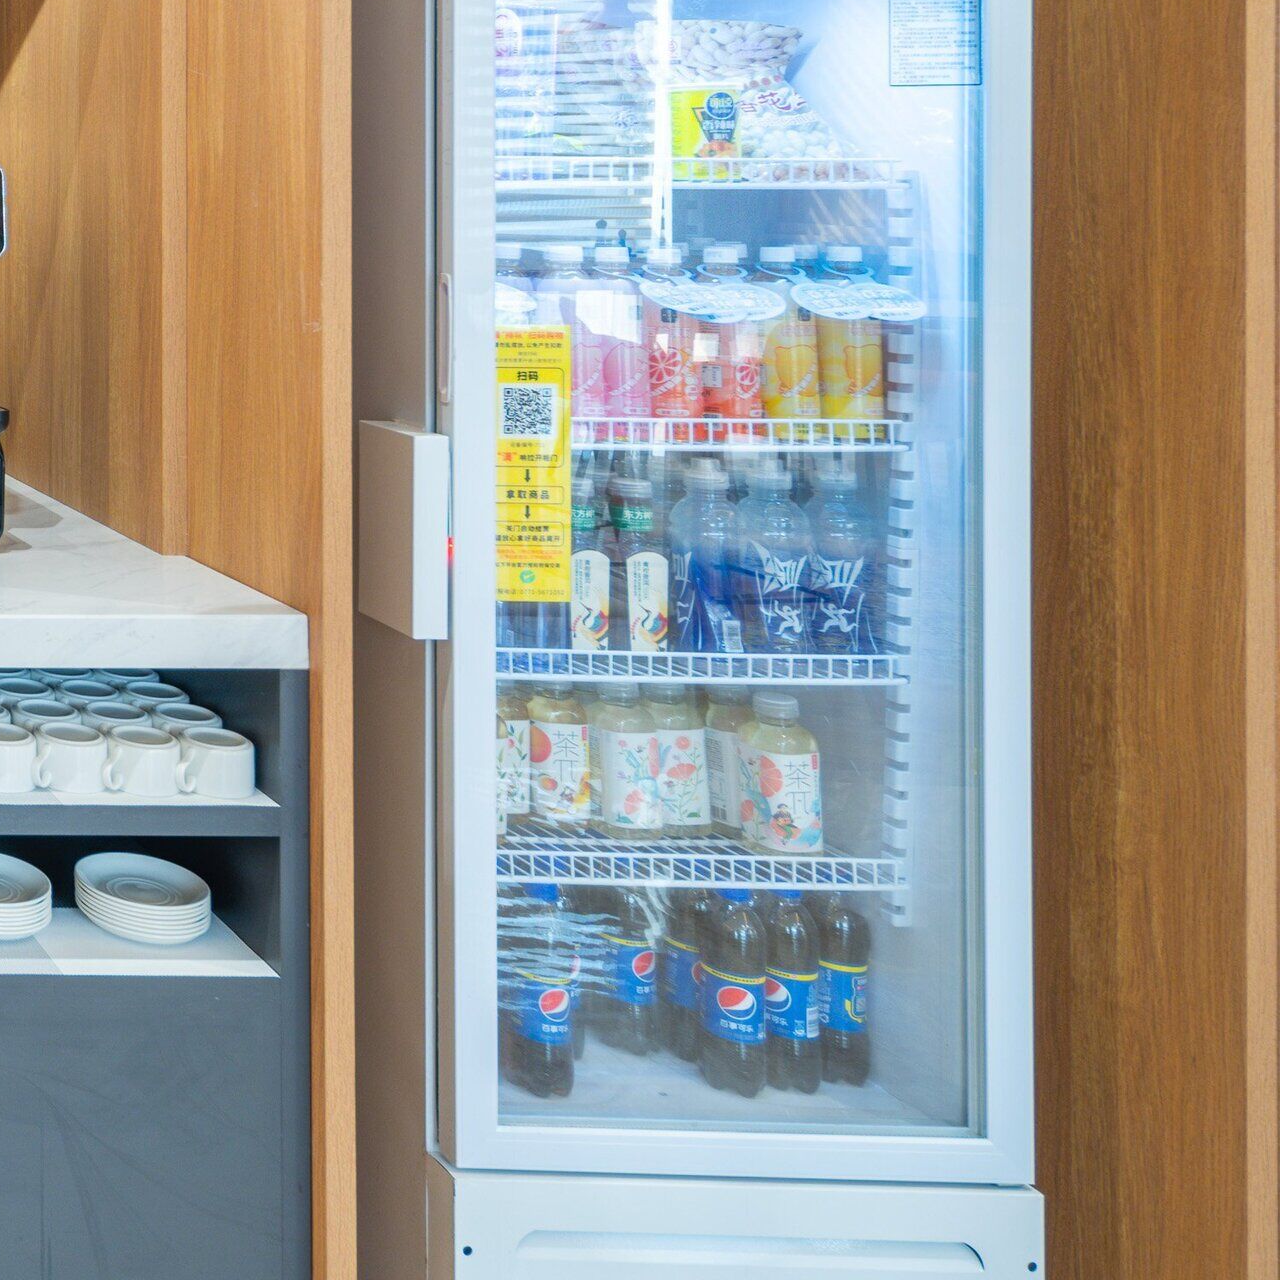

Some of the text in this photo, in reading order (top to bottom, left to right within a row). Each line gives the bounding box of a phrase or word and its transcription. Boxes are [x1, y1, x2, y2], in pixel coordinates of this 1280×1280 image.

[517, 370, 539, 381] 扫码
[506, 489, 550, 500] 拿取商品
